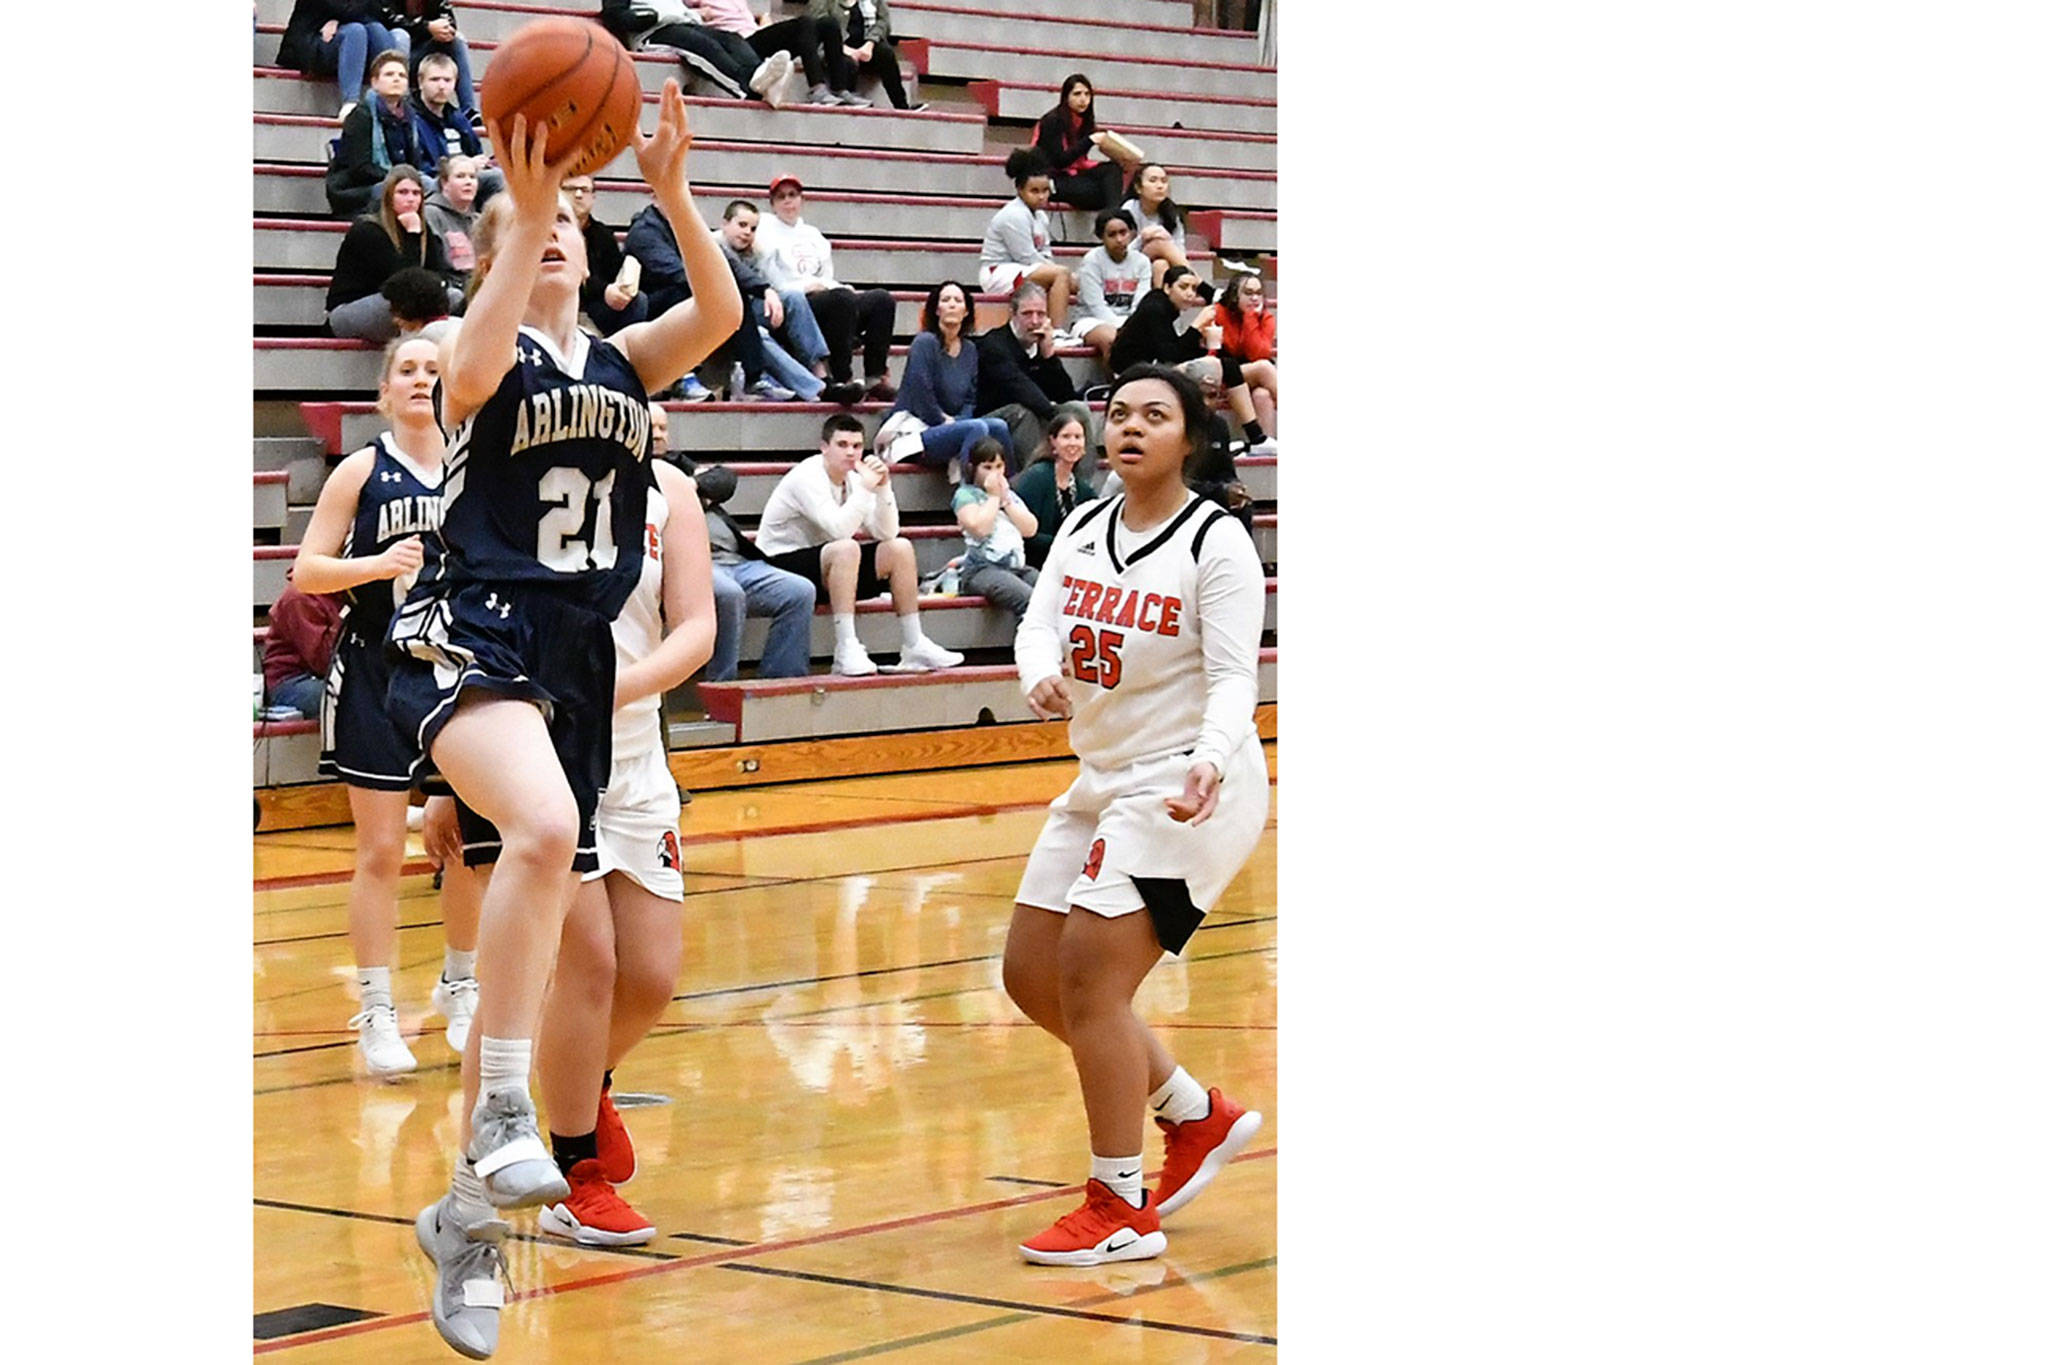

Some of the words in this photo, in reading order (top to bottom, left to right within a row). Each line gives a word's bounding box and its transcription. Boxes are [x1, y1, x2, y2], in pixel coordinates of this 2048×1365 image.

[510, 384, 650, 464] ARLINGTON
[376, 495, 446, 543] ARLIN
[537, 466, 619, 573] 21
[1069, 624, 1124, 690] 25
